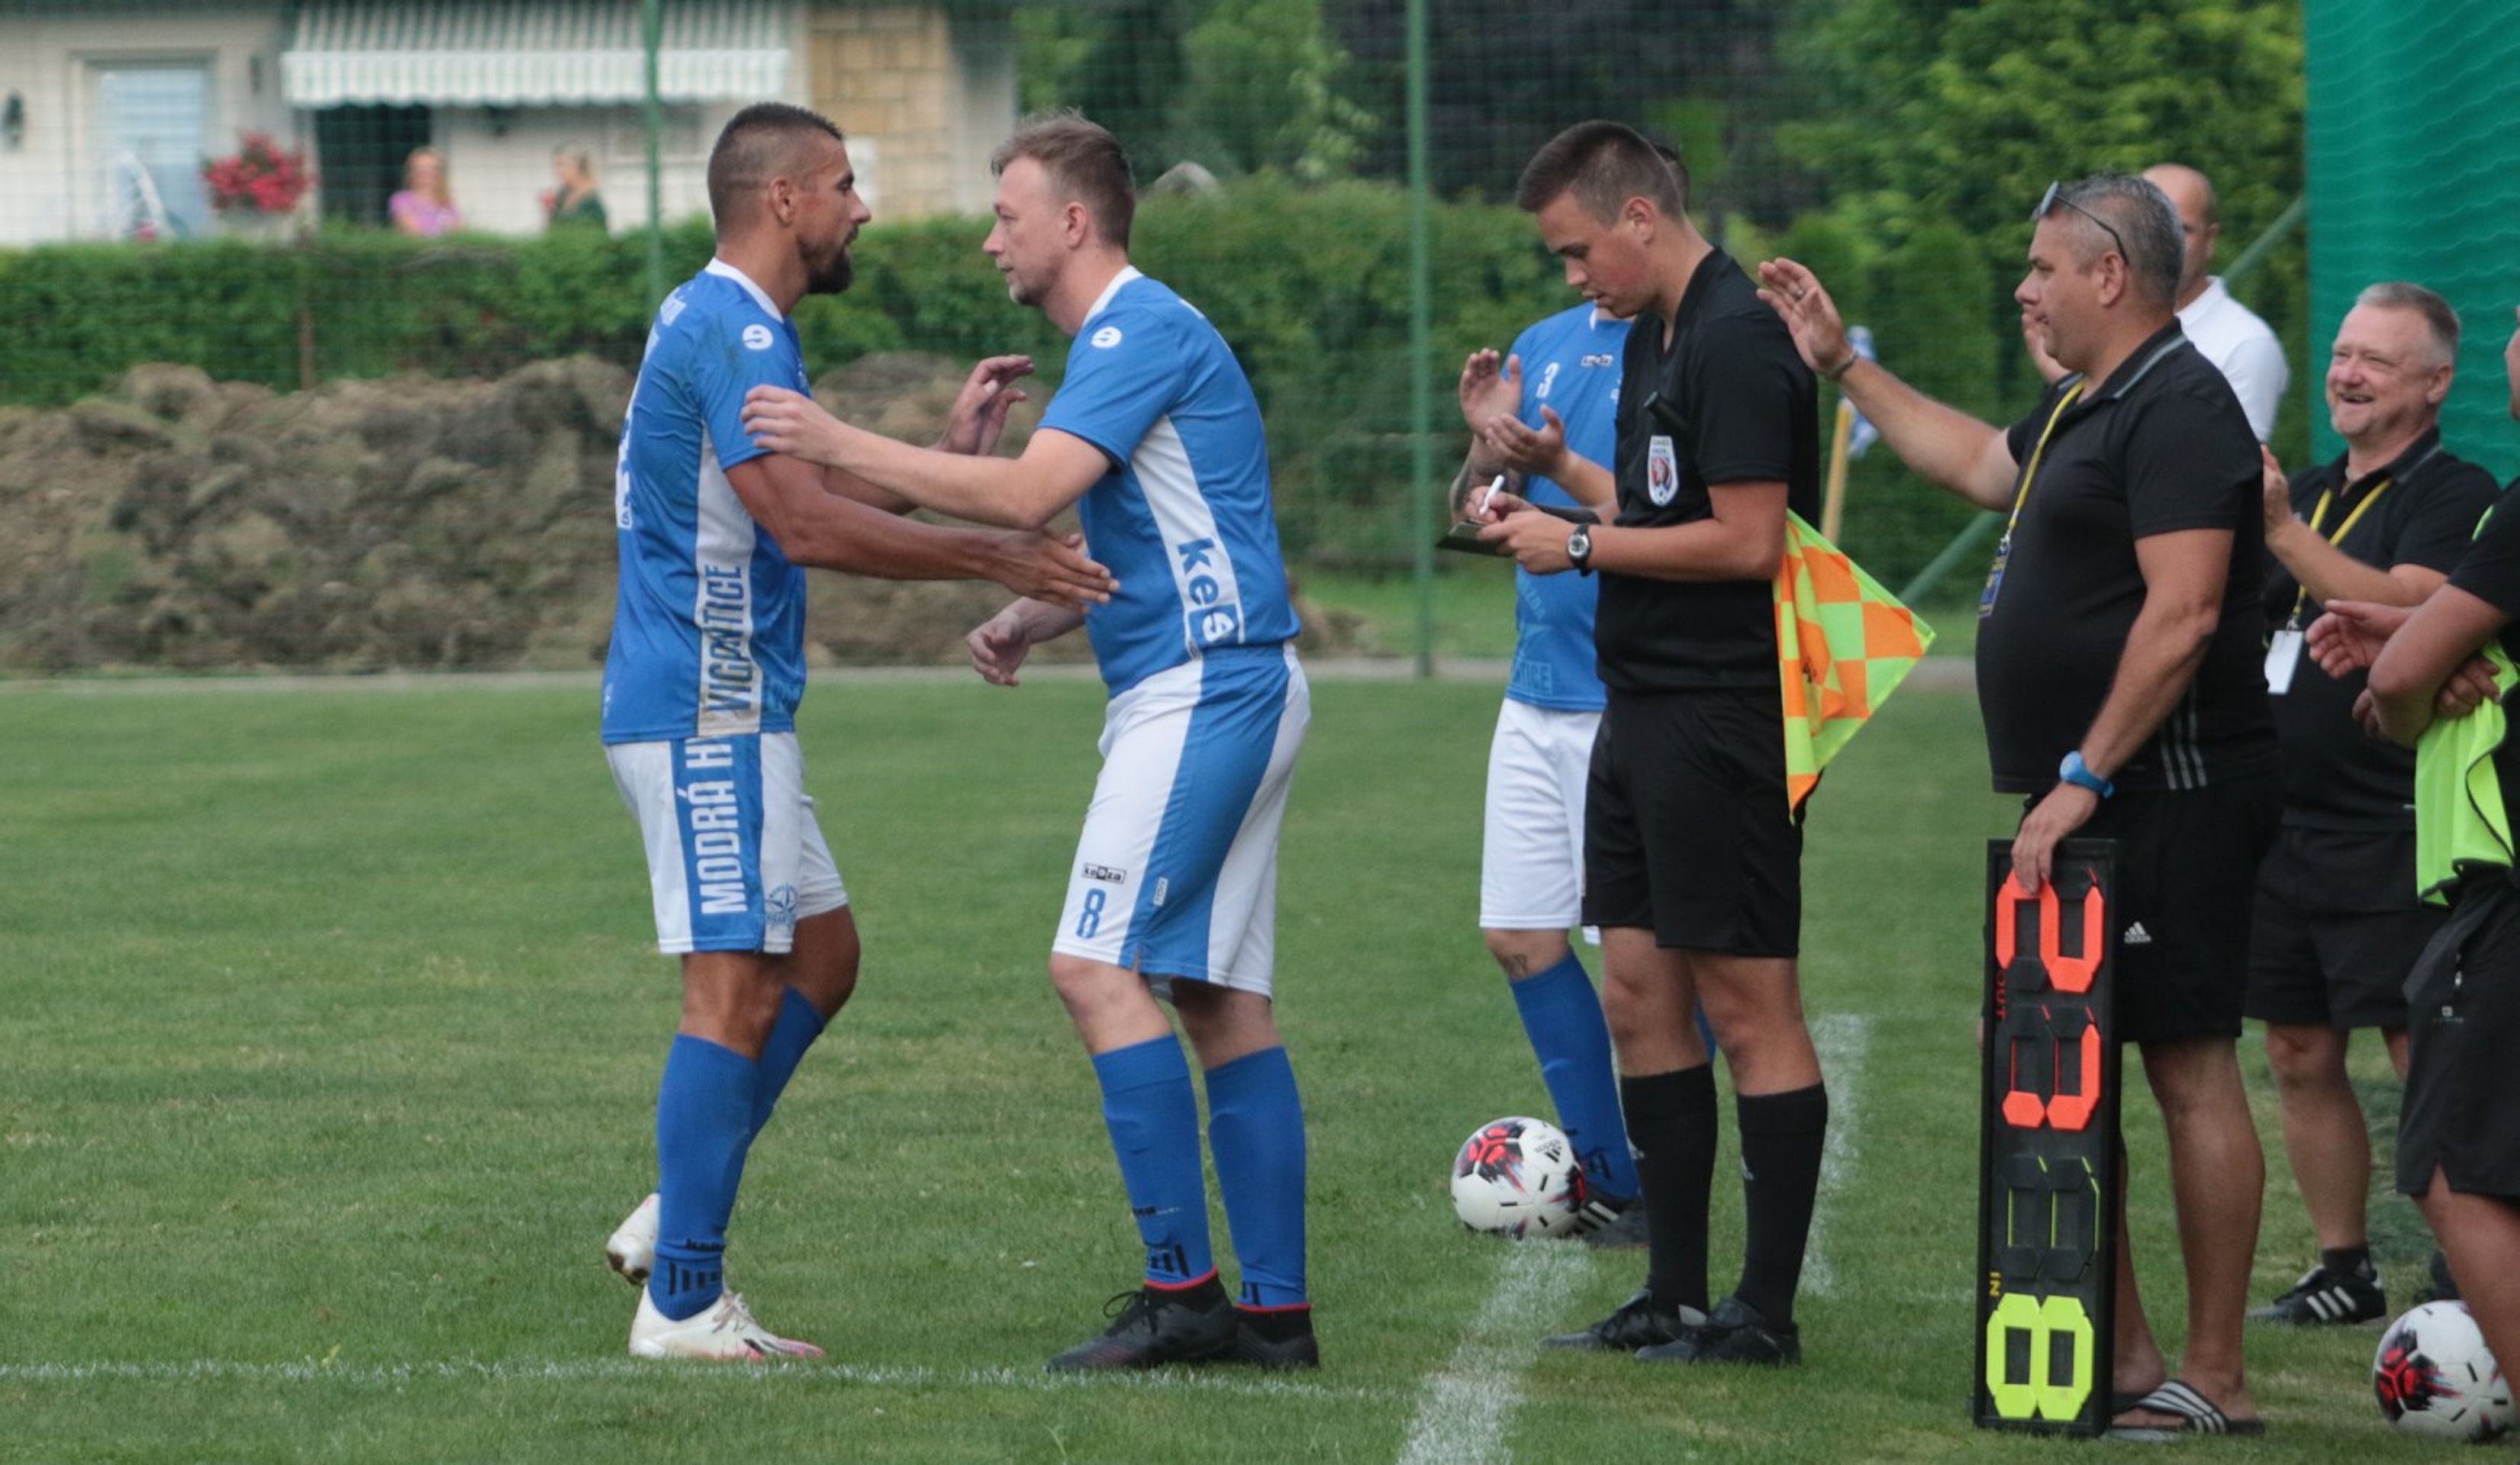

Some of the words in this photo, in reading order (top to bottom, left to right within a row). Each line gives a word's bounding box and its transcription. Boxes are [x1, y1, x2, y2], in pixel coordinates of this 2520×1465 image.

[1536, 362, 1559, 398] 3
[704, 565, 752, 710] VIGANTICE
[676, 781, 747, 914] MODRÁ
[1075, 888, 1106, 939] 8
[1989, 1272, 2001, 1297] IN
[1986, 1293, 2094, 1422] 8
